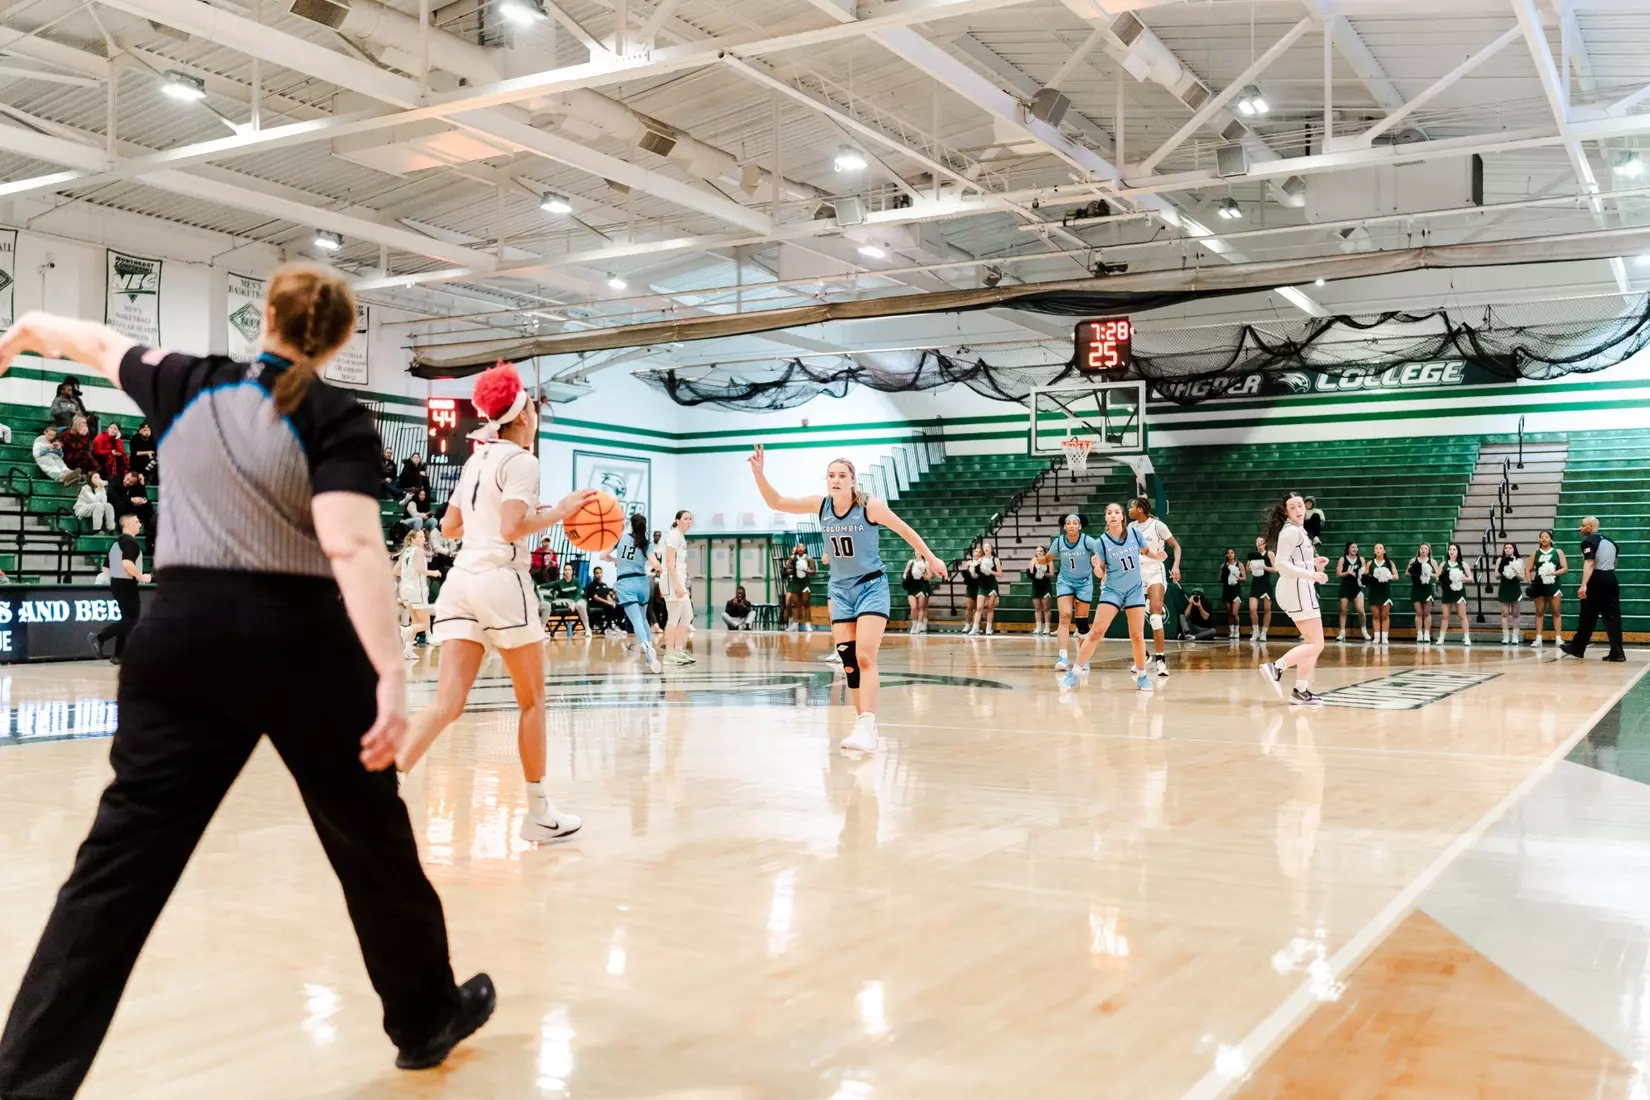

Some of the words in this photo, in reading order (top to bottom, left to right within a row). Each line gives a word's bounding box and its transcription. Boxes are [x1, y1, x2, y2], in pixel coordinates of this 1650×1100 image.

[1091, 321, 1129, 341] 7:28
[1088, 341, 1118, 367] 25
[1315, 360, 1465, 391] COLLEGE
[432, 410, 456, 428] 44
[822, 524, 864, 533] COLUMBIA
[621, 544, 636, 561] 12
[829, 535, 855, 559] 10
[1069, 558, 1076, 569] 1
[1120, 555, 1135, 572] 11
[18, 600, 70, 623] AND
[74, 599, 122, 622] BEE
